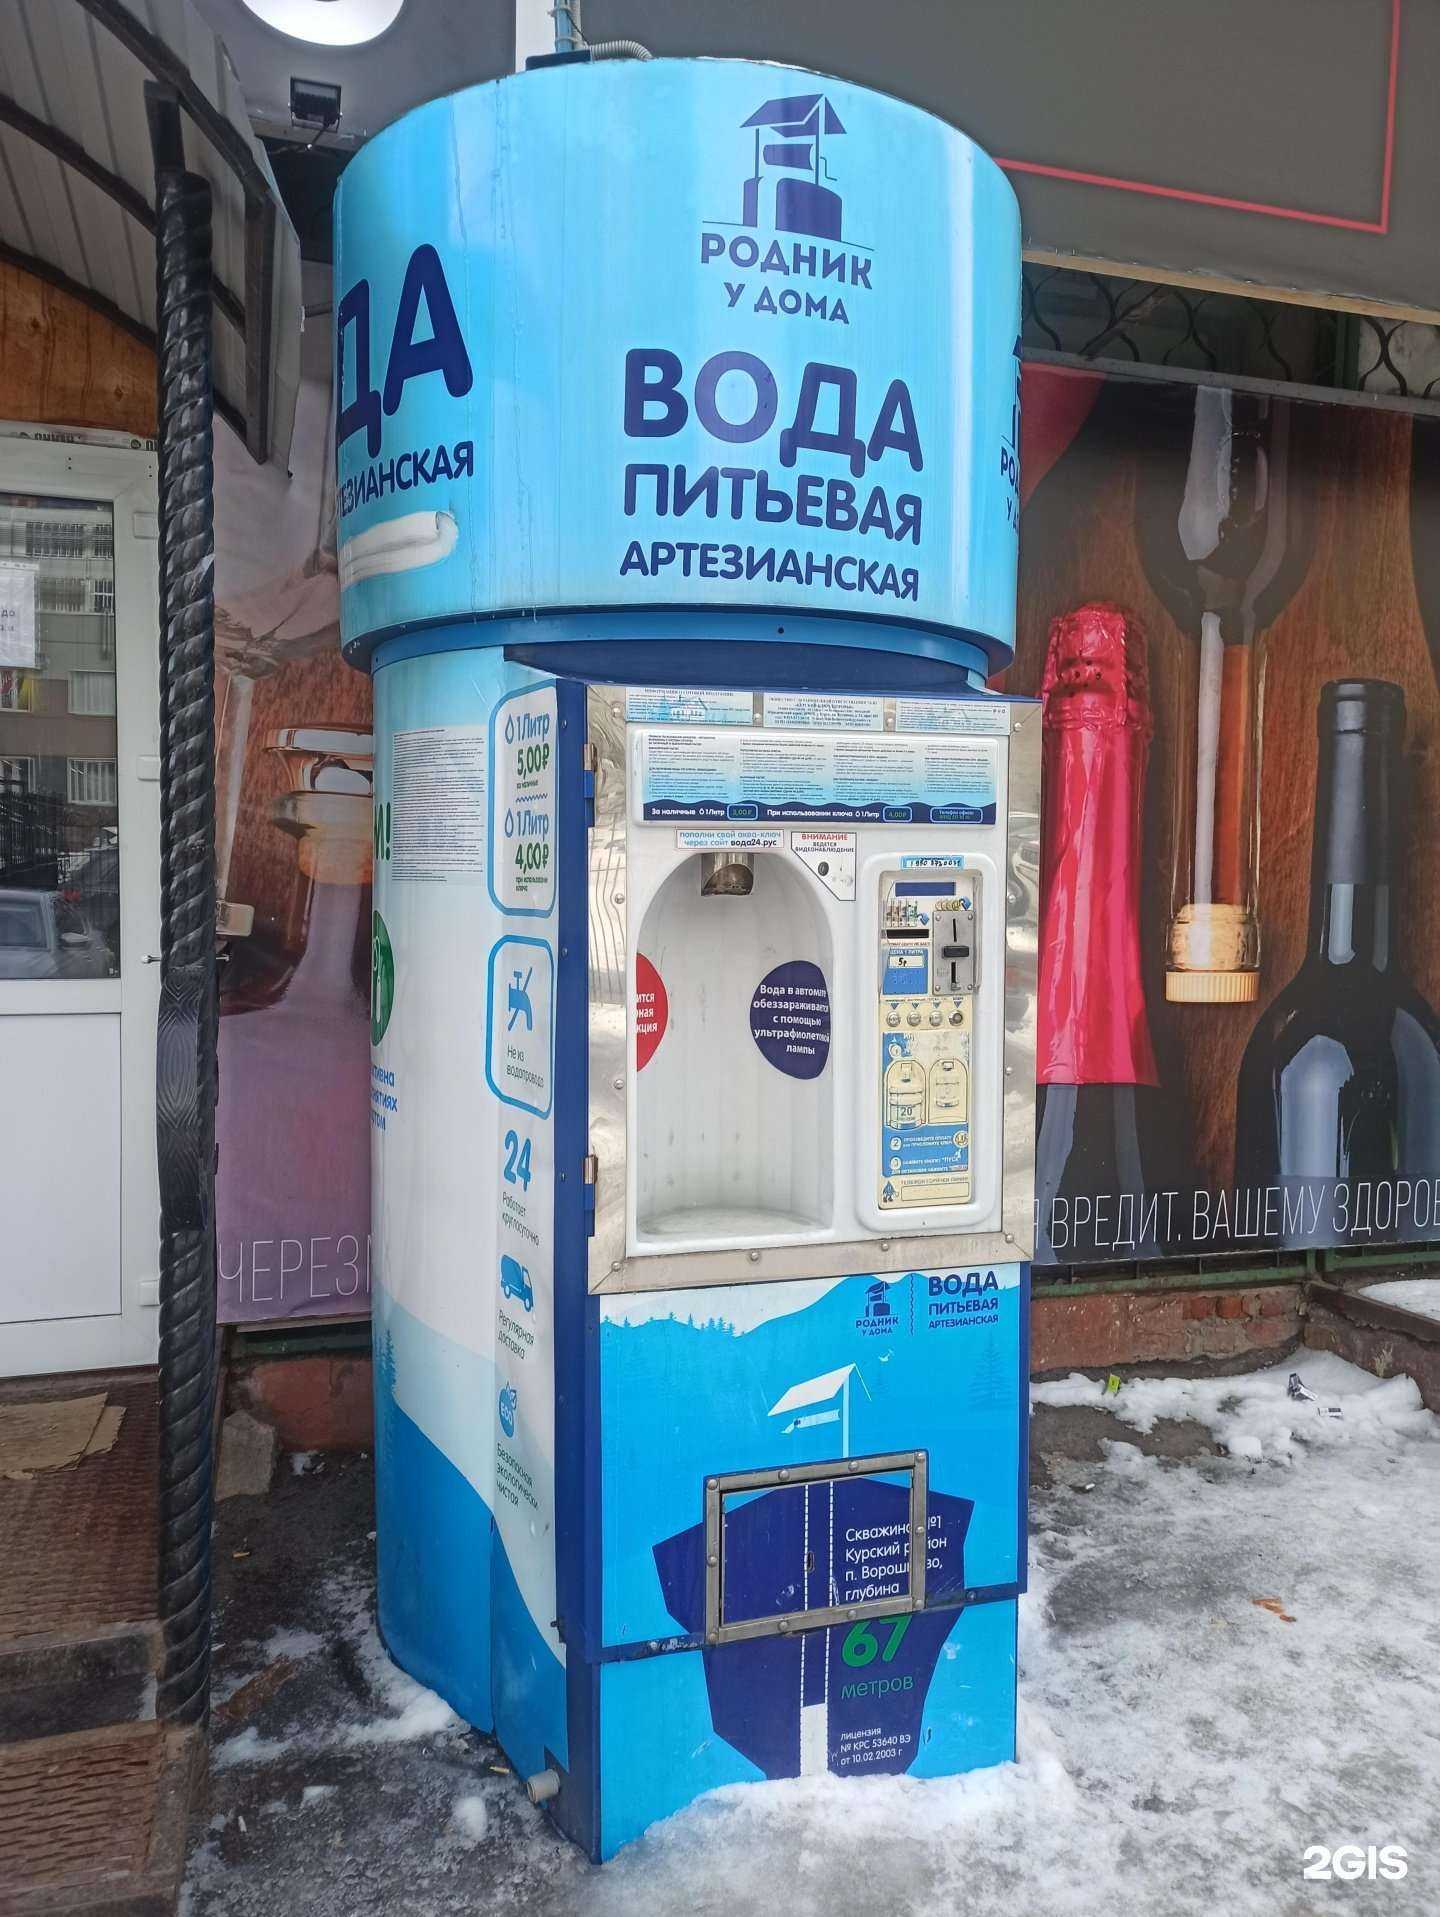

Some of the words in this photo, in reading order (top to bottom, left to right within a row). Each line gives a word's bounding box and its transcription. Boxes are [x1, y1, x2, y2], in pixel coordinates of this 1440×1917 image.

[700, 231, 873, 290] РОДНИК
[724, 282, 747, 308] У
[754, 285, 850, 325] ДОМА
[623, 347, 924, 478] ВОДА
[337, 440, 474, 519] ЕЗИАНСКАЯ
[623, 462, 923, 546] ПИТЬЕВАЯ
[619, 539, 920, 602] АРТЕЗИАНСКАЯ
[680, 831, 714, 839] пополни
[717, 830, 736, 839] свой
[738, 831, 781, 839] аква-ключ
[684, 840, 711, 849] через
[730, 838, 777, 848] вода24.рус
[801, 833, 848, 841] ВНИМАНИЕ
[795, 845, 855, 853] ВИДЕОНАБЛЮДЕНИЕ
[760, 984, 786, 997] Вода
[787, 987, 793, 995] в
[772, 1015, 779, 1023] с
[780, 1016, 822, 1028] помощью
[786, 1044, 815, 1055] лампы
[504, 1129, 532, 1193] 24
[1051, 1191, 1182, 1252] ВРЕДИТ.
[1192, 1184, 1326, 1241] ВАШЕМУ
[928, 1271, 999, 1298] ВОДА
[928, 1298, 999, 1316] ПИТЬЕВАЯ
[856, 1317, 899, 1329] РОДНИК
[928, 1314, 999, 1330] АРТЕЗИАНСКАЯ
[869, 1328, 893, 1336] ДОМА
[845, 1541, 900, 1564] Курский
[845, 1570, 858, 1582] п.
[845, 1583, 900, 1602] глубина
[841, 1615, 912, 1667] 67
[841, 1676, 913, 1700] метров
[841, 1727, 882, 1741] лицензия
[841, 1743, 852, 1753] №
[853, 1740, 870, 1751] КРС
[872, 1736, 898, 1748] 53640
[841, 1756, 851, 1766] от
[852, 1748, 896, 1764] 10.02.2003
